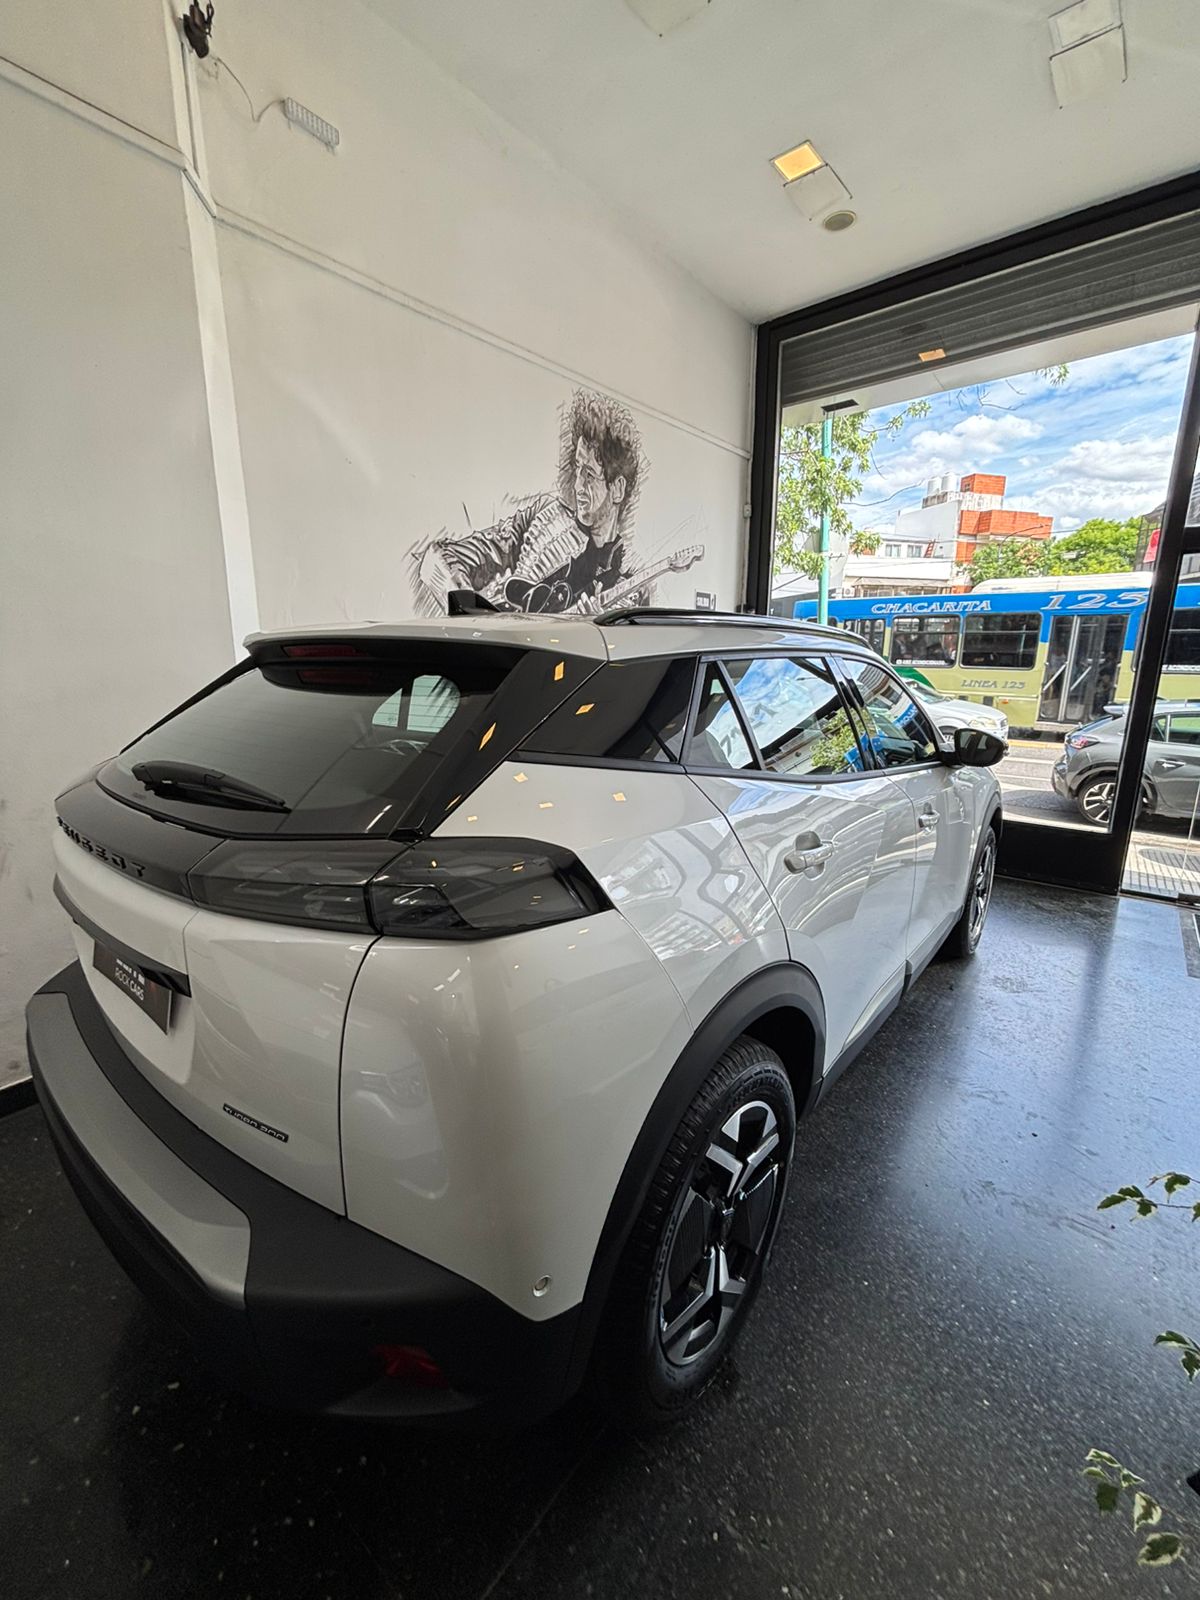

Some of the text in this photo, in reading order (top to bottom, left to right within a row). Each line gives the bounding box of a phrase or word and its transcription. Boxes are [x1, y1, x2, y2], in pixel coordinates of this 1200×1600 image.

[871, 600, 992, 614] CHACARITA
[961, 679, 998, 689] LINEA
[129, 979, 145, 1001] CARS
